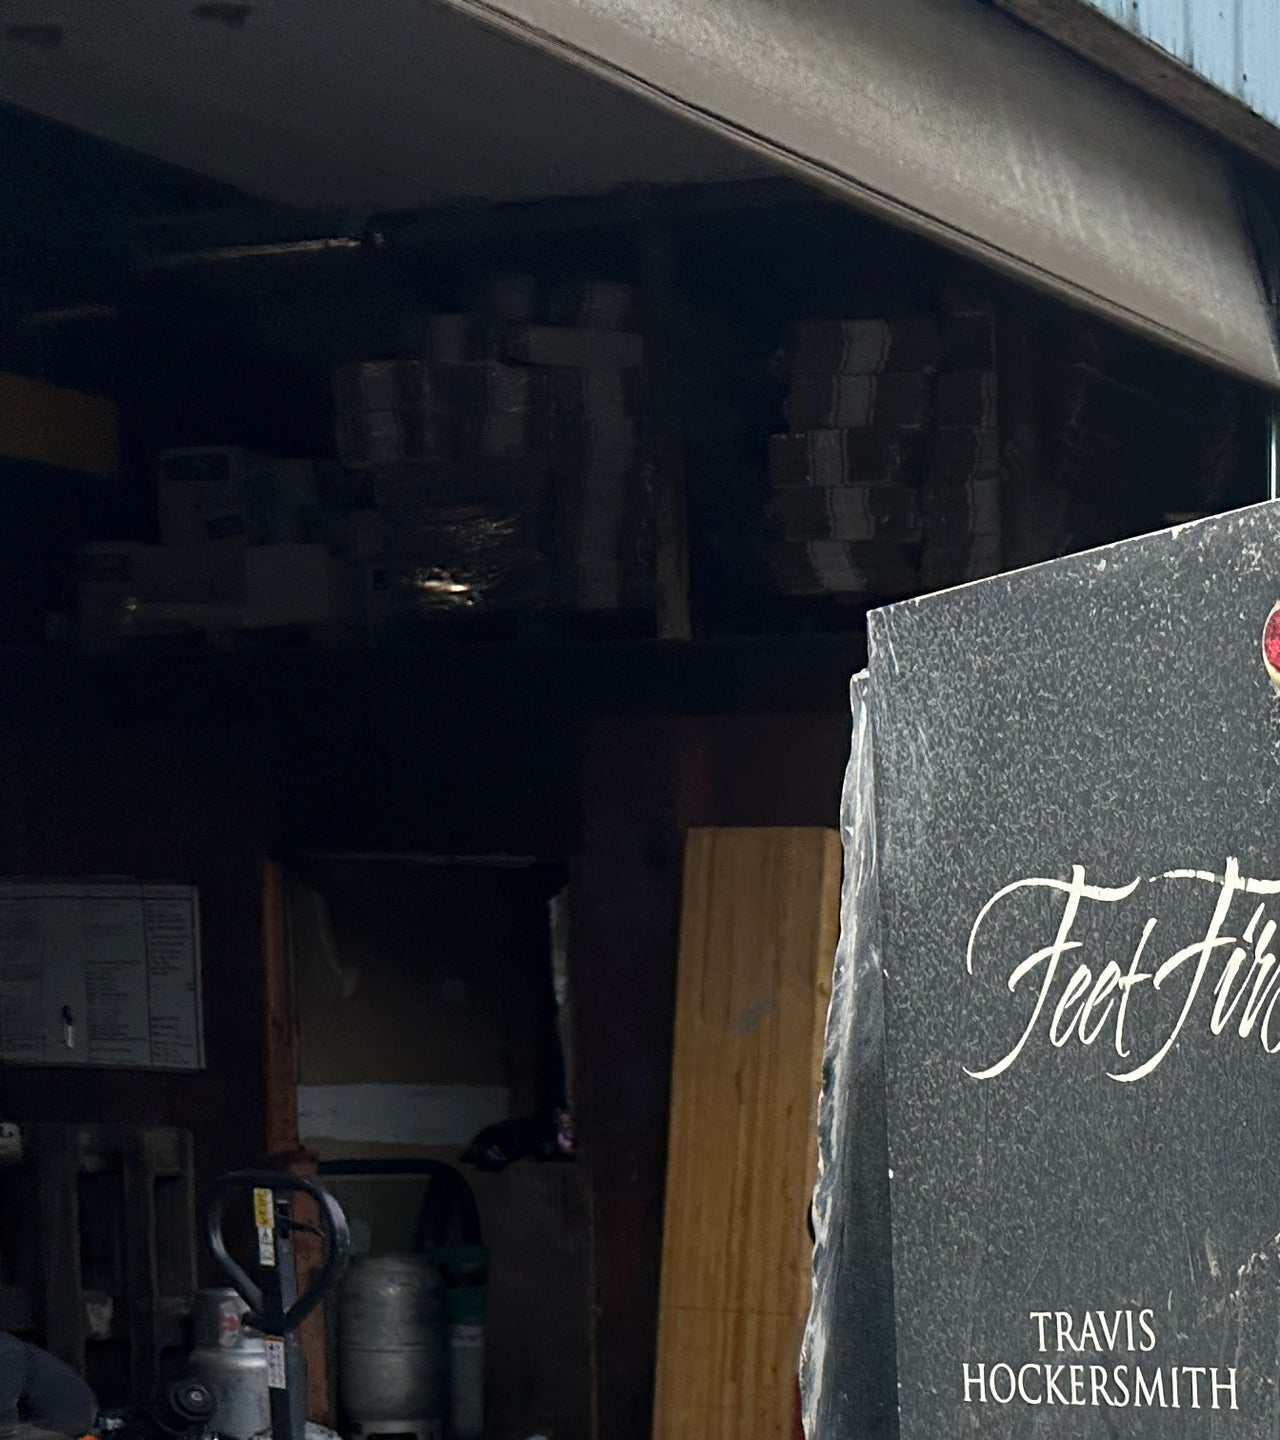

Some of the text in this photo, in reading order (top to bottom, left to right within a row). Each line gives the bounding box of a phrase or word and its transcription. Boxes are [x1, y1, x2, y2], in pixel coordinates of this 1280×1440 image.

[963, 864, 1158, 1080] Feet
[1029, 1308, 1157, 1352] TRAVIS
[962, 1362, 1240, 1411] HOCKERSMITH
